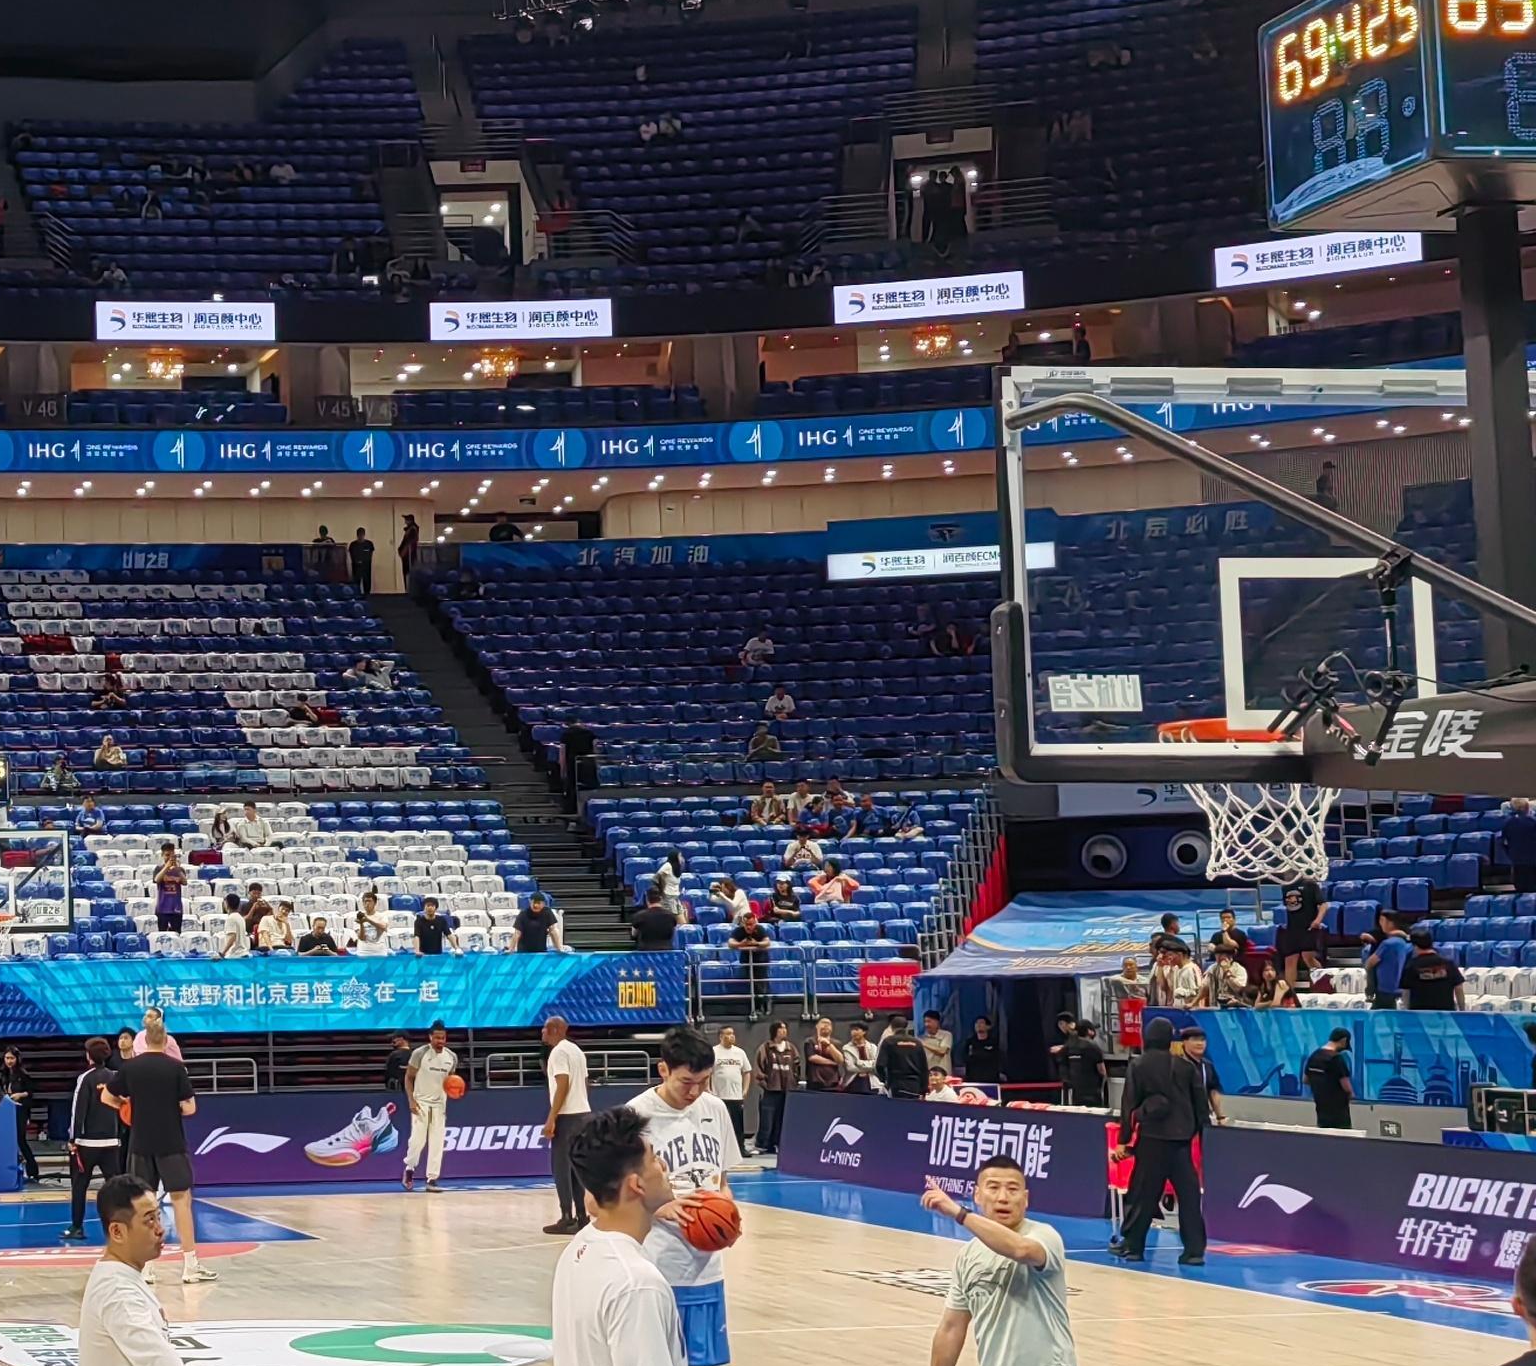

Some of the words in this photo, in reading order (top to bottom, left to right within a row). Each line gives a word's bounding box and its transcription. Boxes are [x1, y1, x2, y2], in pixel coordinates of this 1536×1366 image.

[601, 438, 639, 455] IHG
[798, 430, 837, 447] IHG
[28, 443, 65, 458] IHG
[220, 443, 256, 459] IHG
[408, 442, 445, 458] IHG
[577, 545, 710, 566] 北汽加油
[134, 982, 333, 1008] 北京越野和北京男篮
[375, 981, 440, 1003] 在一起
[618, 981, 656, 1008] BEIJING
[443, 1124, 551, 1152] BUCKE
[907, 1114, 1054, 1179] 一切皆有可能
[820, 1148, 862, 1167] LI-NING
[1395, 1218, 1478, 1262] 牛仔宇宙
